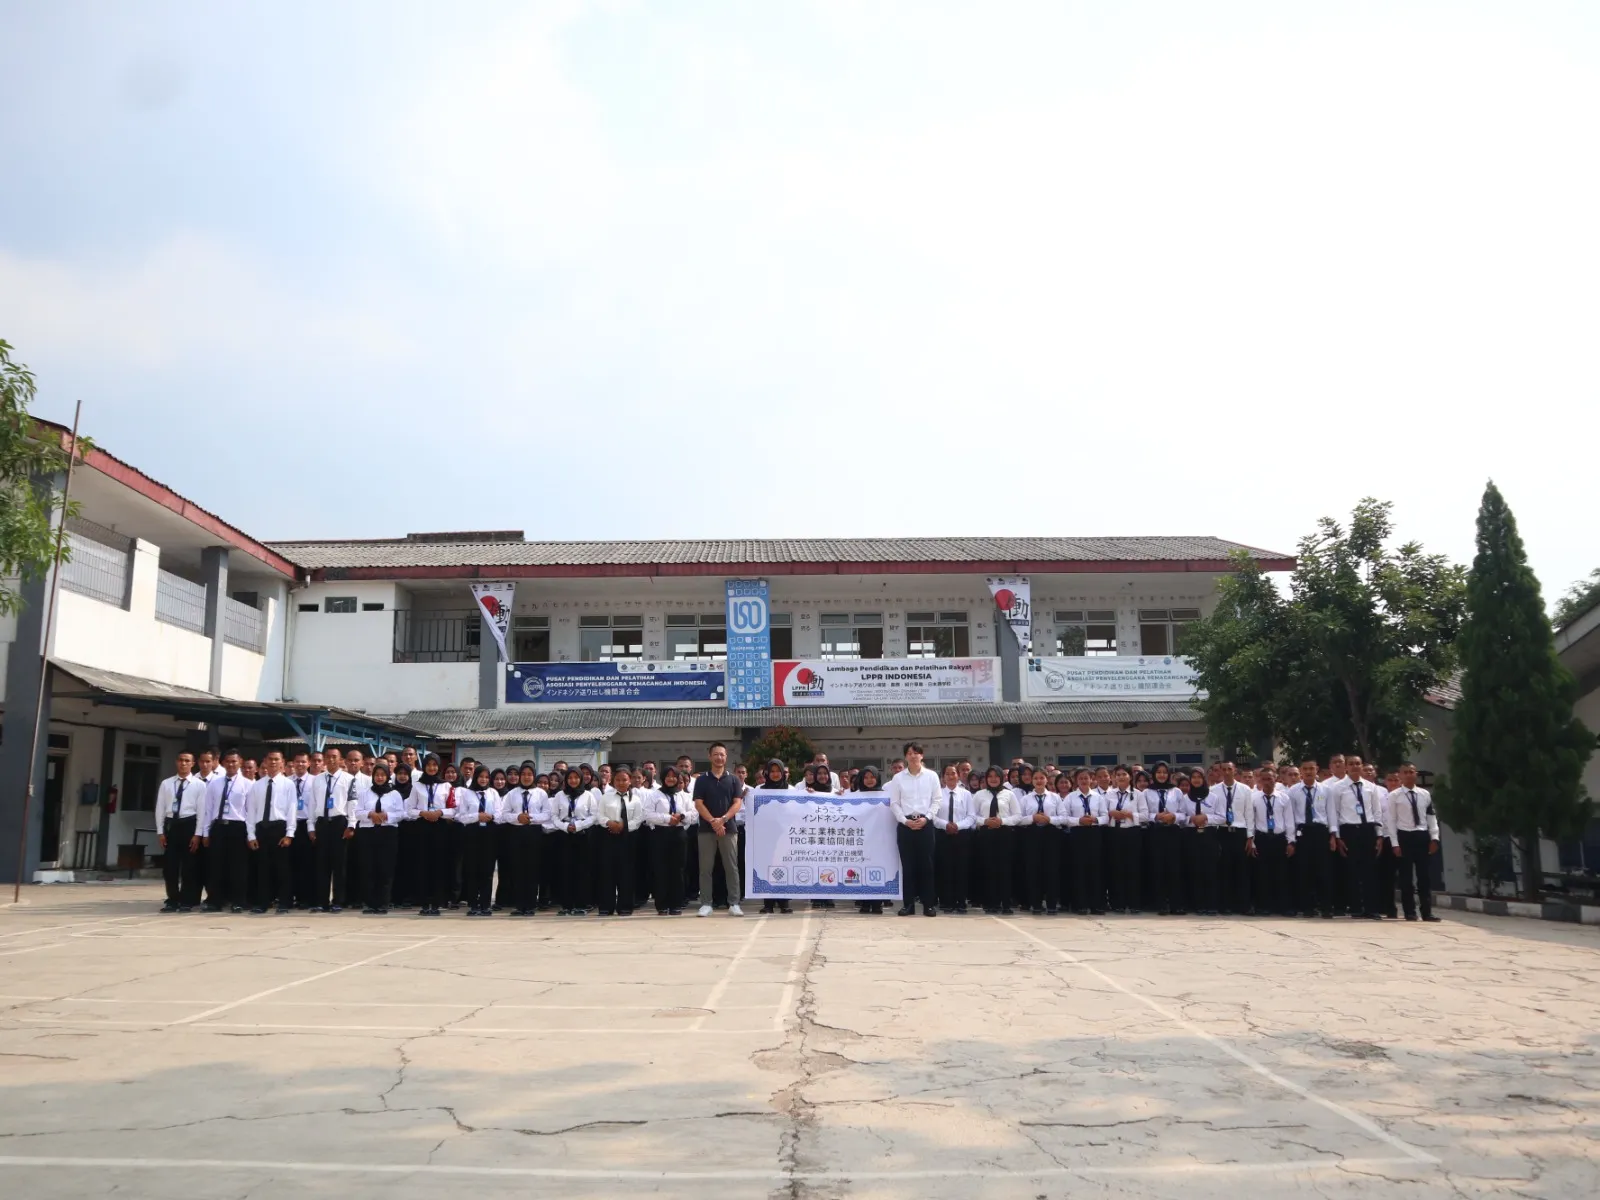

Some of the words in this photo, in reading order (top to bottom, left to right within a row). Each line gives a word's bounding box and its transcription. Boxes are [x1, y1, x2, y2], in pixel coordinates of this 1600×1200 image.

[949, 664, 972, 672] Rakyat
[815, 806, 843, 814] ようこそ
[802, 815, 858, 823] インドネシアへ
[788, 827, 866, 836] 久米工業株式会社
[788, 836, 865, 846] TRC事業協同組合
